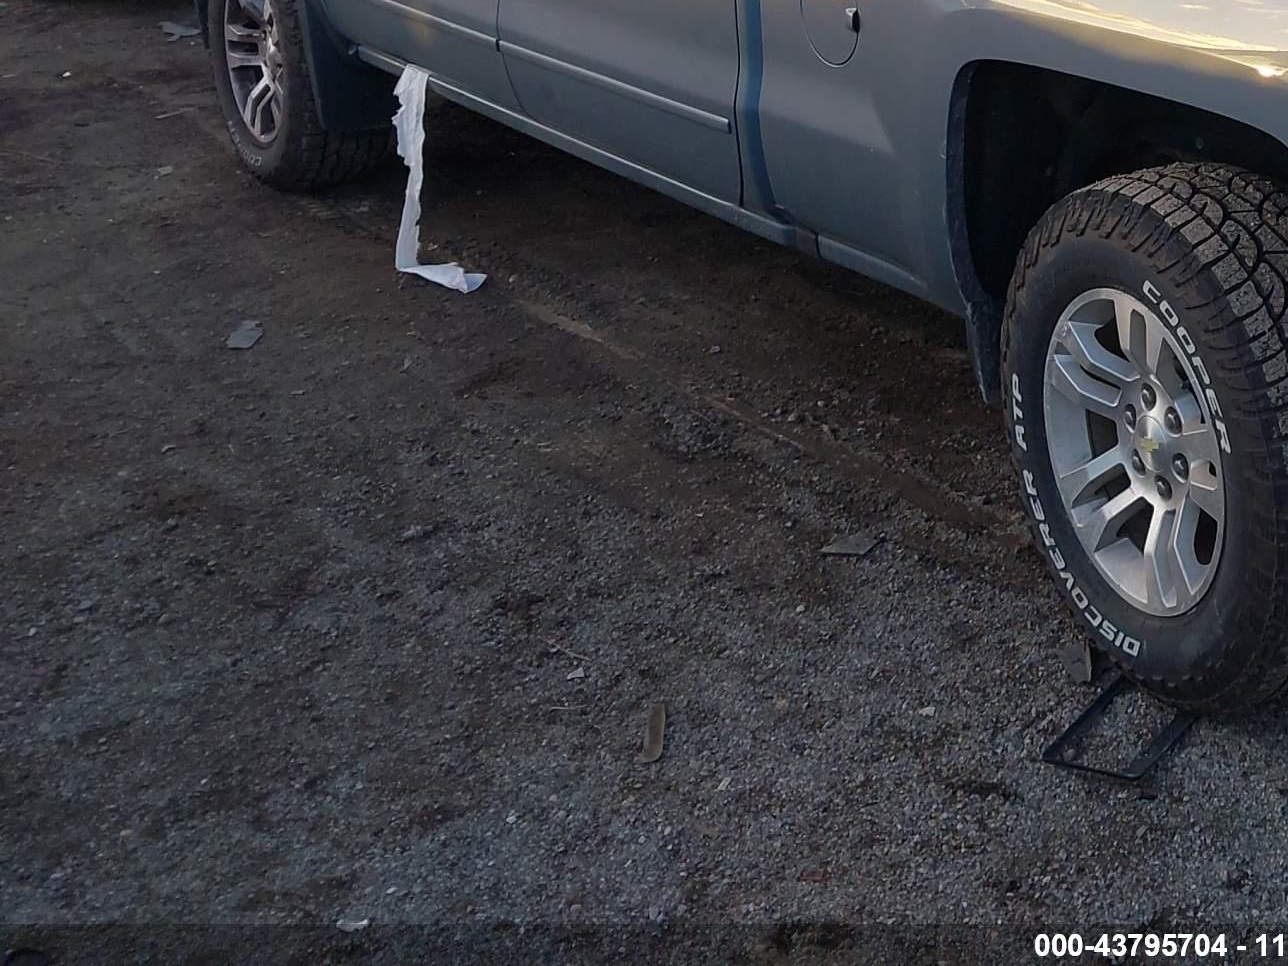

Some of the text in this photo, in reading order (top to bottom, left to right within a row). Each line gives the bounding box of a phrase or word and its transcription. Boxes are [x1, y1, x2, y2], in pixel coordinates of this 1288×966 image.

[1141, 279, 1233, 455] COOPER
[1011, 372, 1142, 659] DISCOVERER ATP
